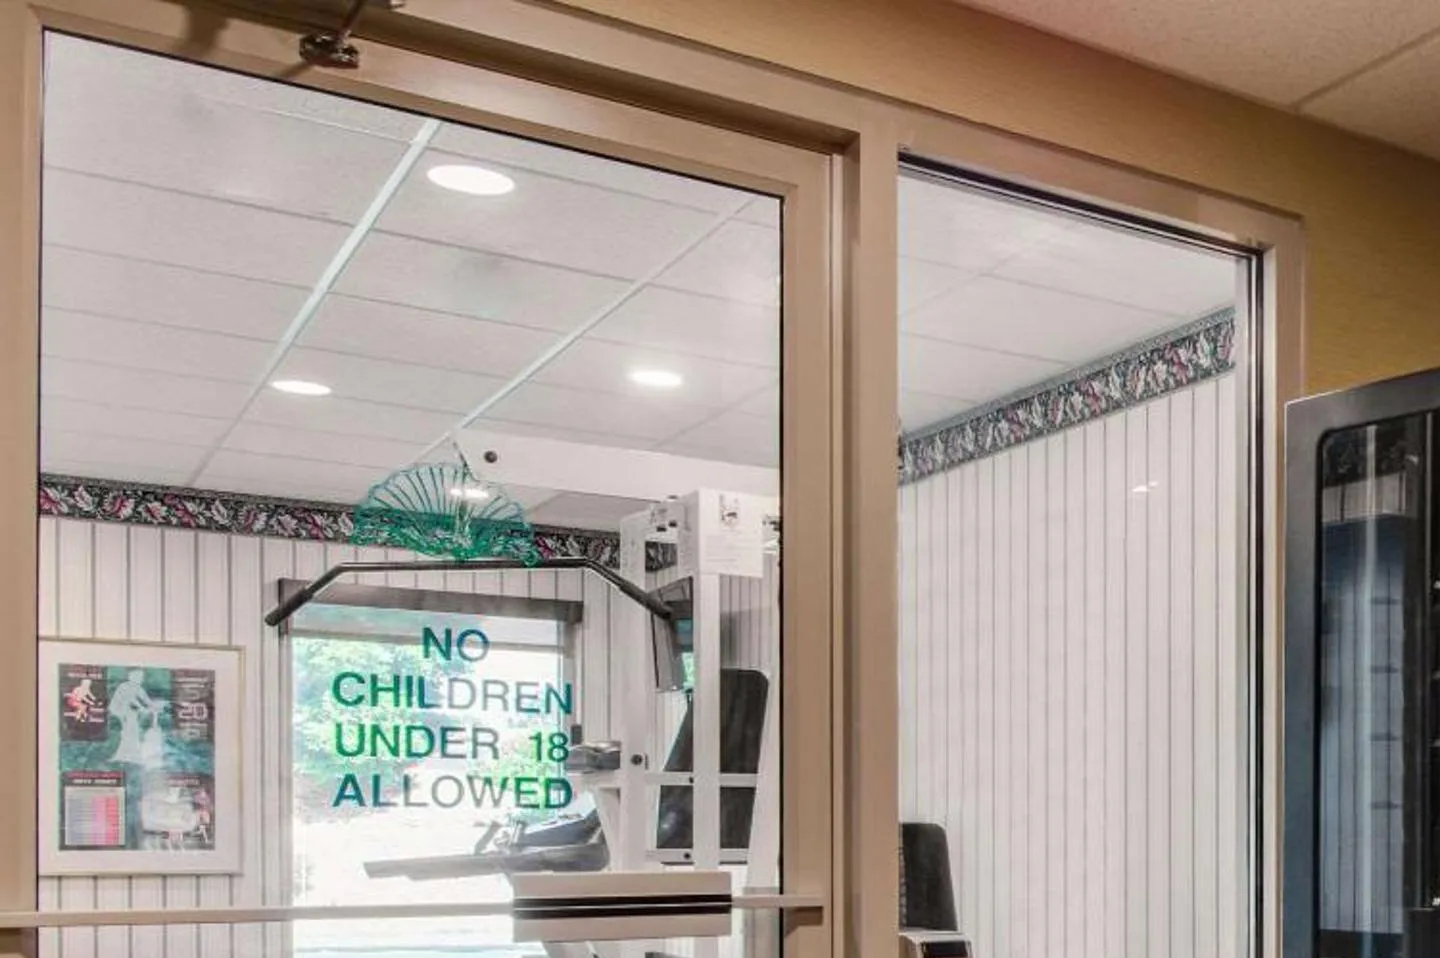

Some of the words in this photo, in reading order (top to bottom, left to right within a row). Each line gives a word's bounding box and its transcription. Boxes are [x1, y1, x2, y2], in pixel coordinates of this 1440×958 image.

[422, 627, 490, 662] NO
[331, 671, 573, 714] CHILDREN
[335, 723, 500, 760] UNDER
[529, 731, 570, 763] 18
[332, 773, 574, 810] ALLOWED
